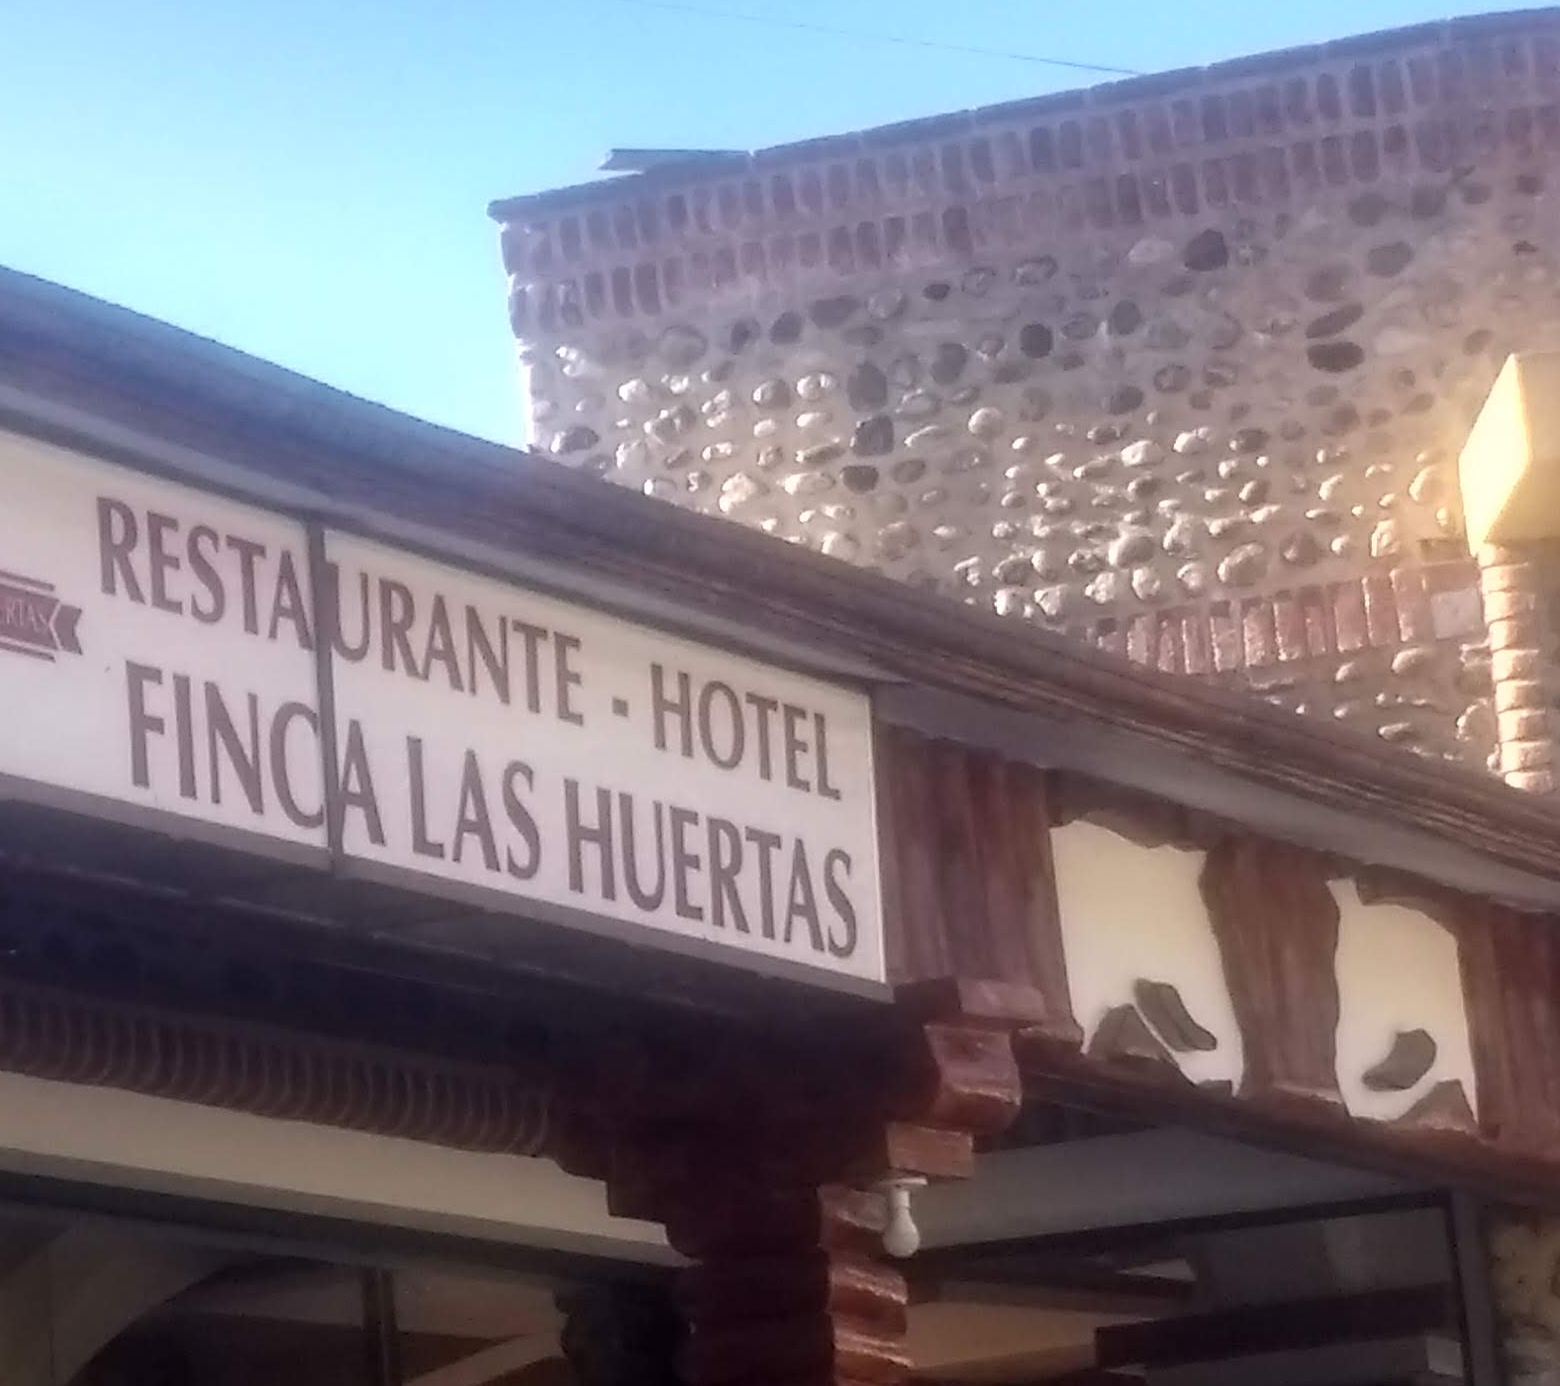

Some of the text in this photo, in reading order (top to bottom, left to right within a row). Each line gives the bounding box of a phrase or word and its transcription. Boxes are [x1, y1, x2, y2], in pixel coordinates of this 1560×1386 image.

[96, 495, 585, 727] RESTAURANTE
[650, 661, 842, 800] HOTEL
[125, 659, 858, 959] FINCA LAS HUERTAS
